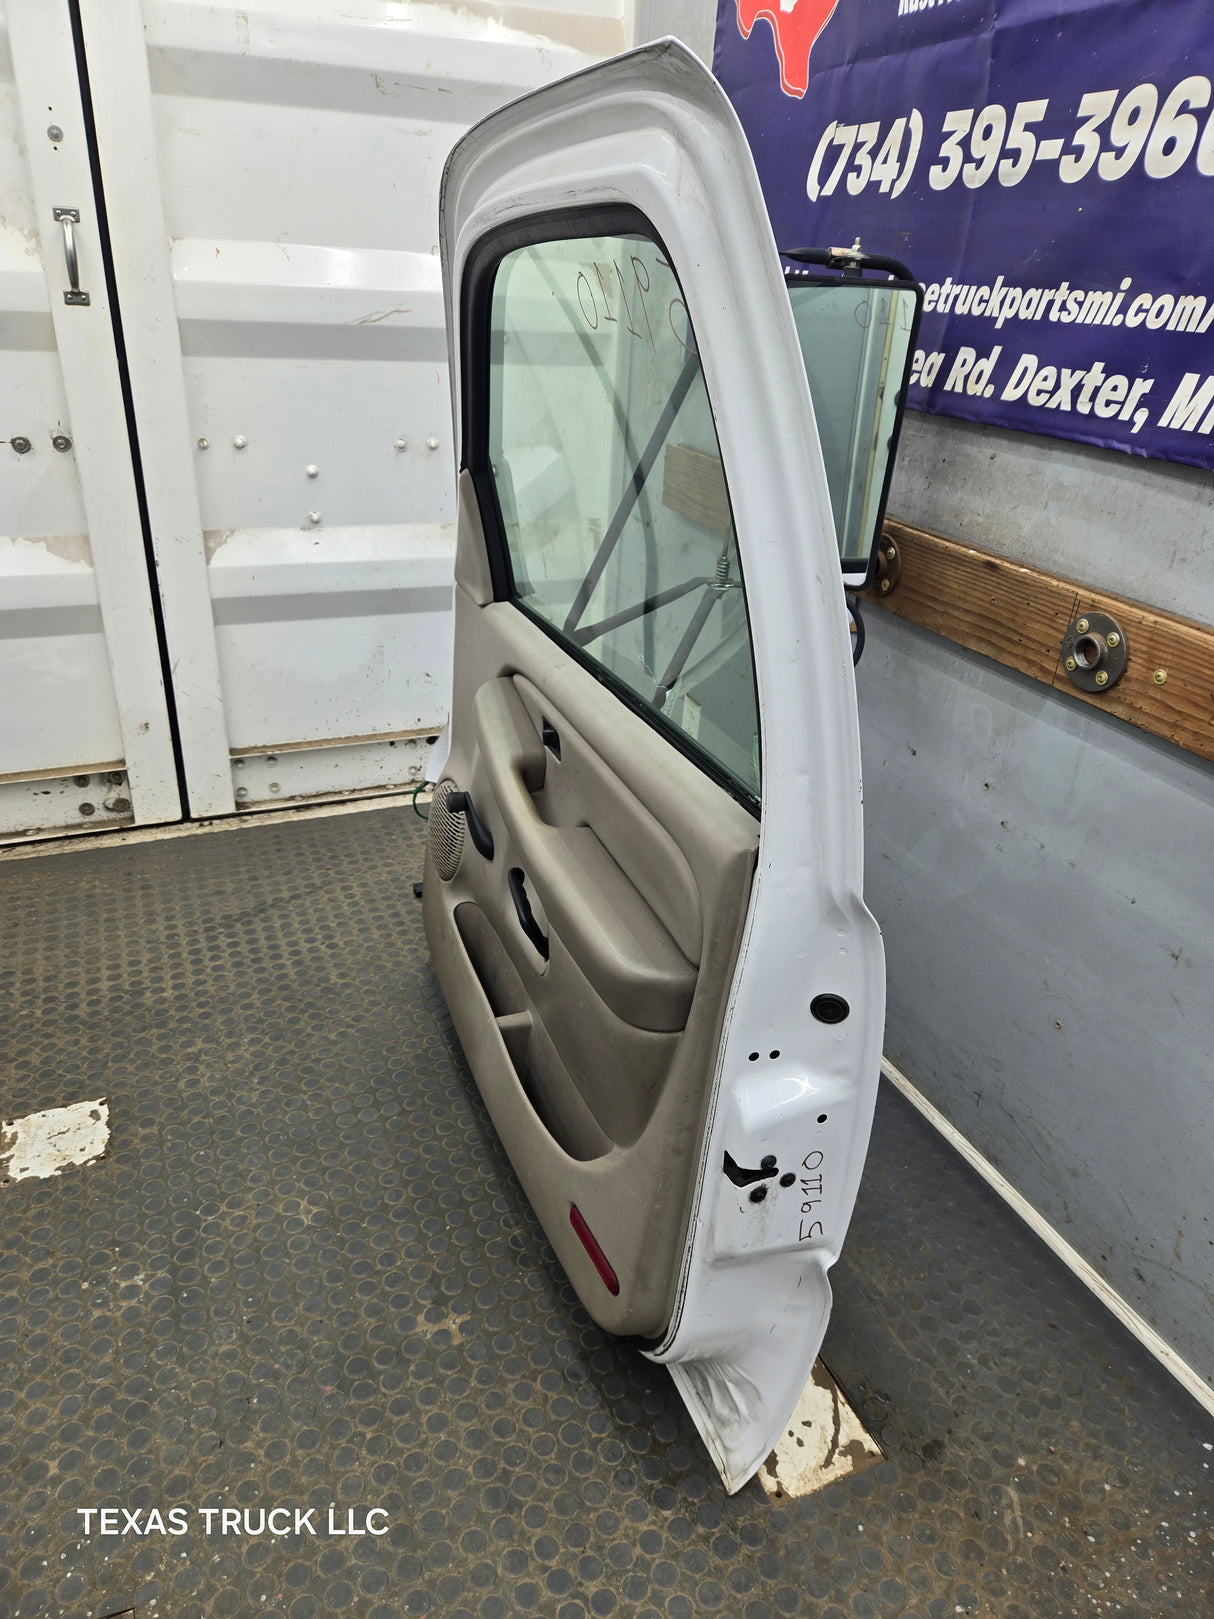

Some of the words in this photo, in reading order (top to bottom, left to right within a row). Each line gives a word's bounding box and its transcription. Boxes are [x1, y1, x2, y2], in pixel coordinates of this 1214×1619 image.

[806, 108, 923, 202] (734)
[909, 349, 946, 388] ea
[943, 345, 1003, 398] Rd.
[1000, 353, 1155, 434] Dexter,
[799, 1151, 824, 1241] 59110
